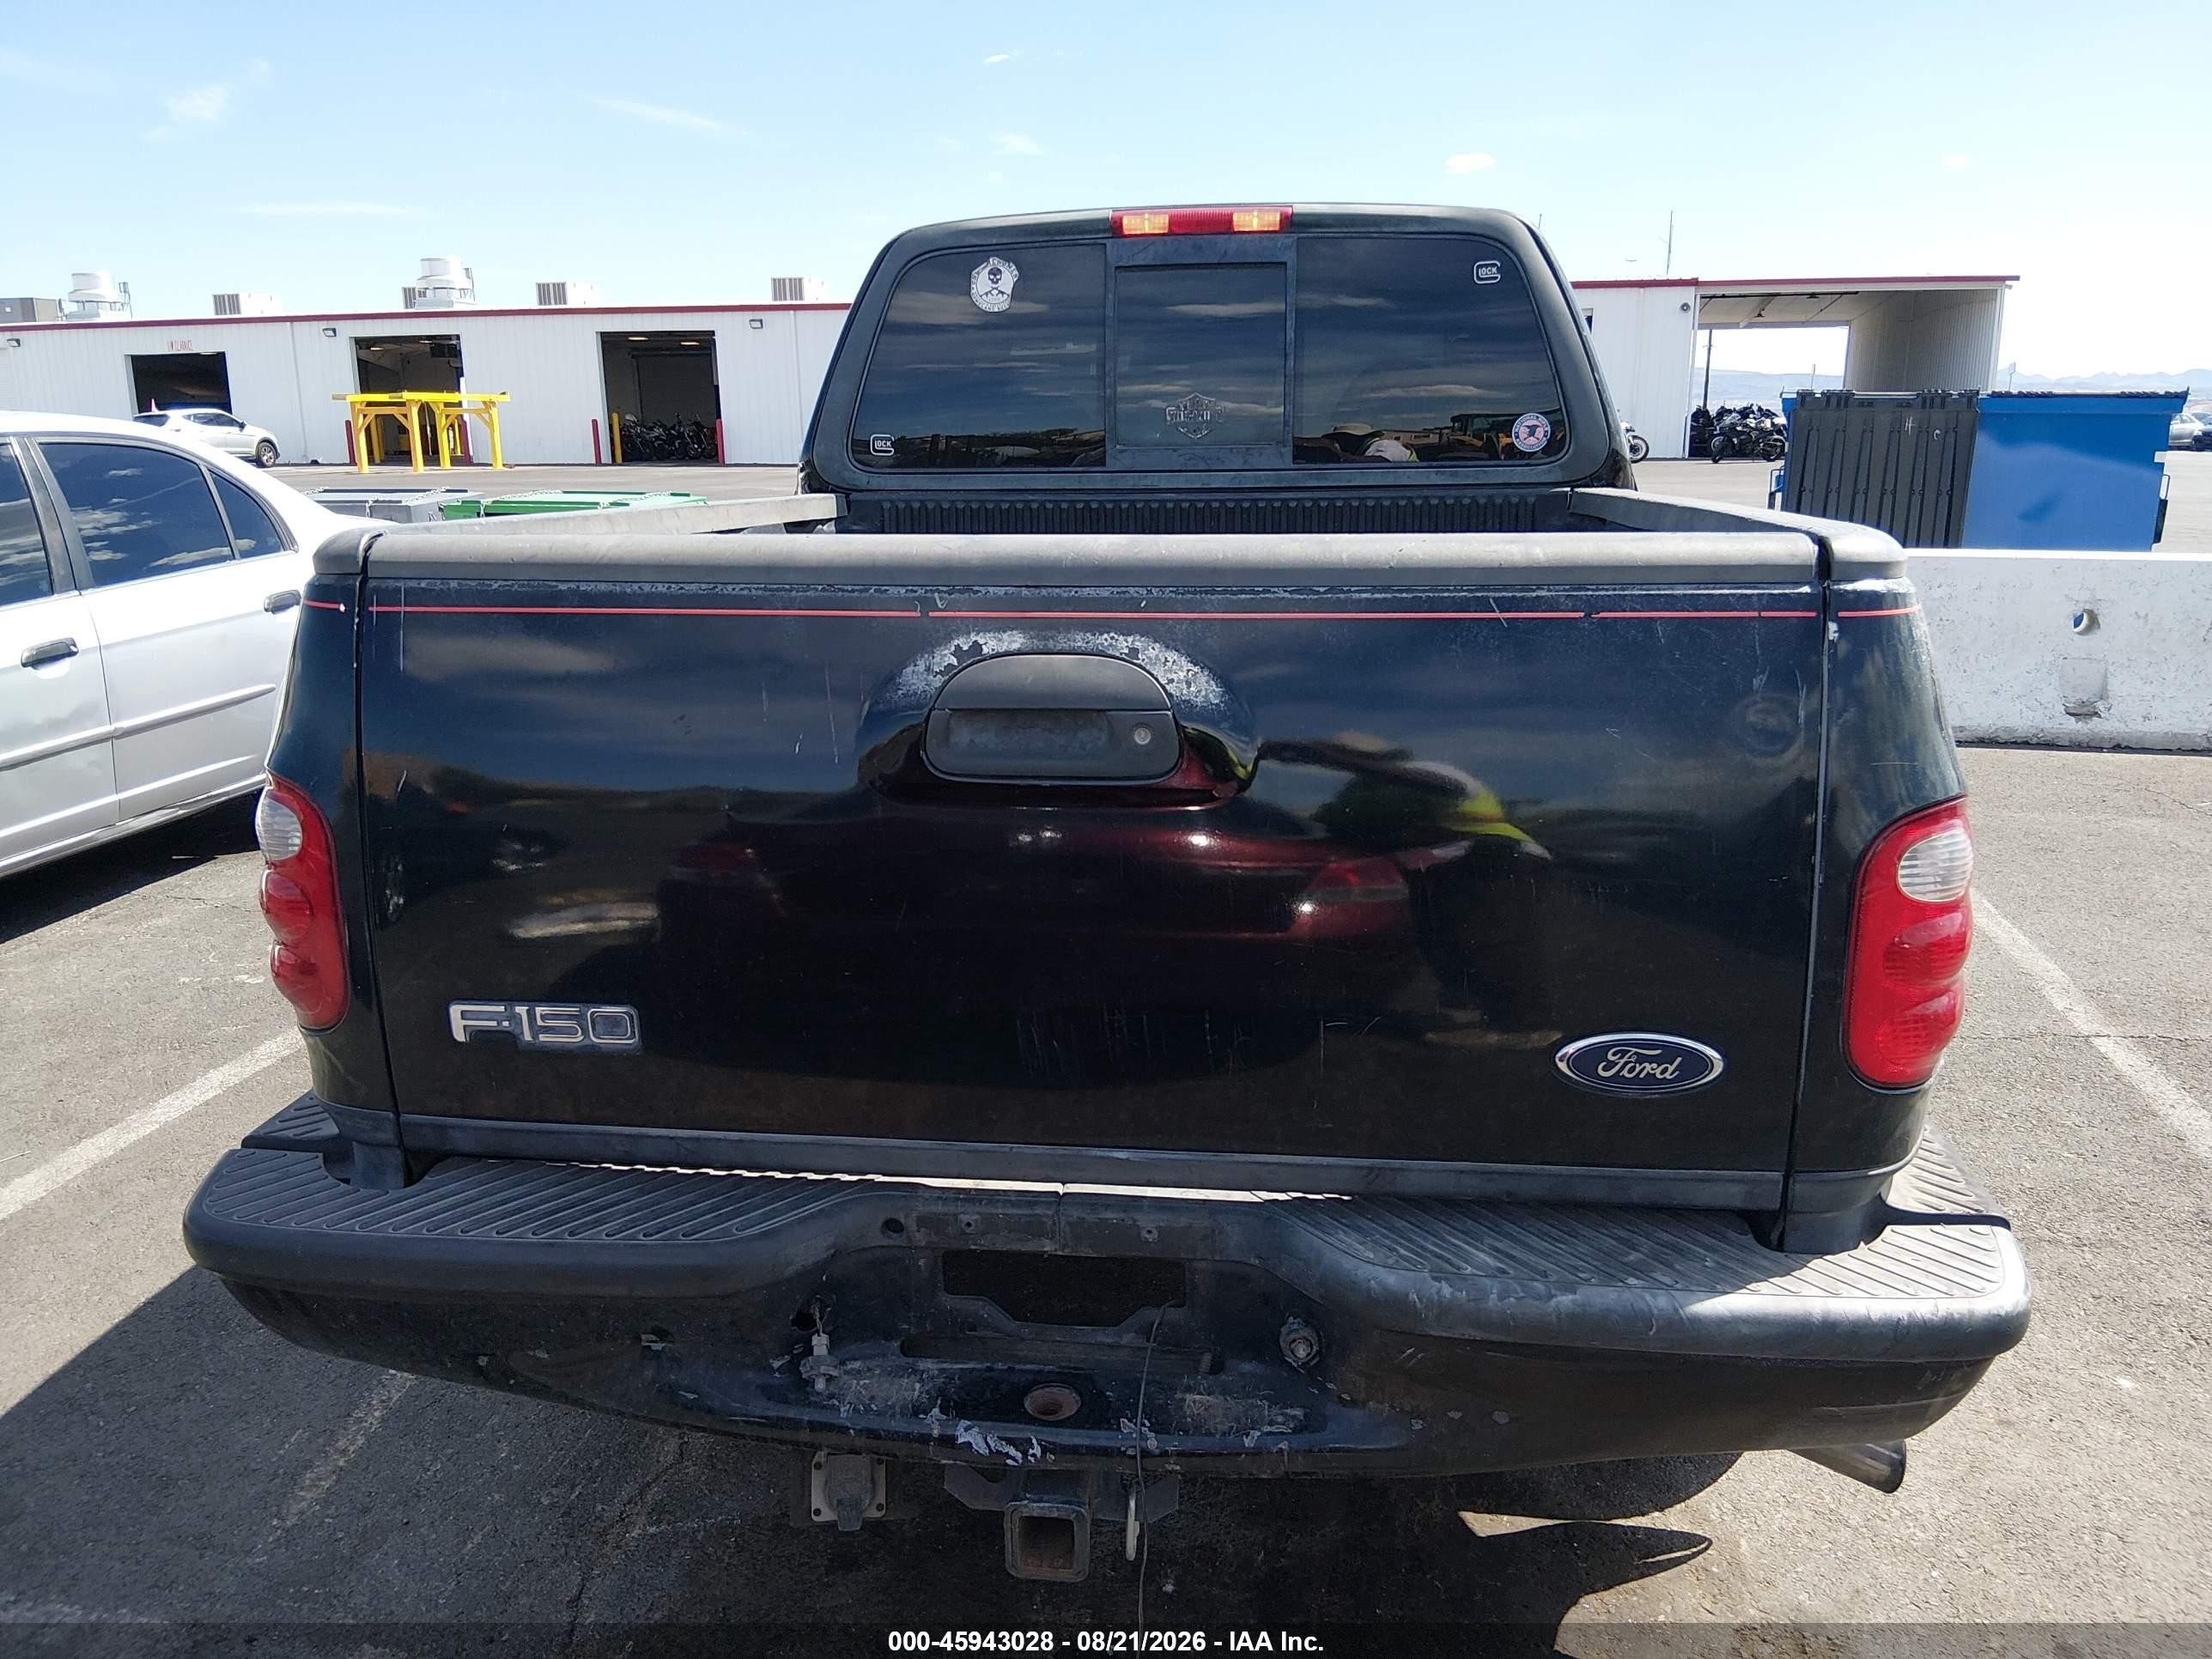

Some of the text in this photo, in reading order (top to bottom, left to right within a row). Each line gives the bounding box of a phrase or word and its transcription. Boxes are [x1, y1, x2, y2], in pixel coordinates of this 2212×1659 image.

[1474, 260, 1501, 284] GLOCK
[870, 434, 895, 456] GLOCK
[449, 1004, 640, 1044] F-150
[1597, 1047, 1683, 1079] Ford
